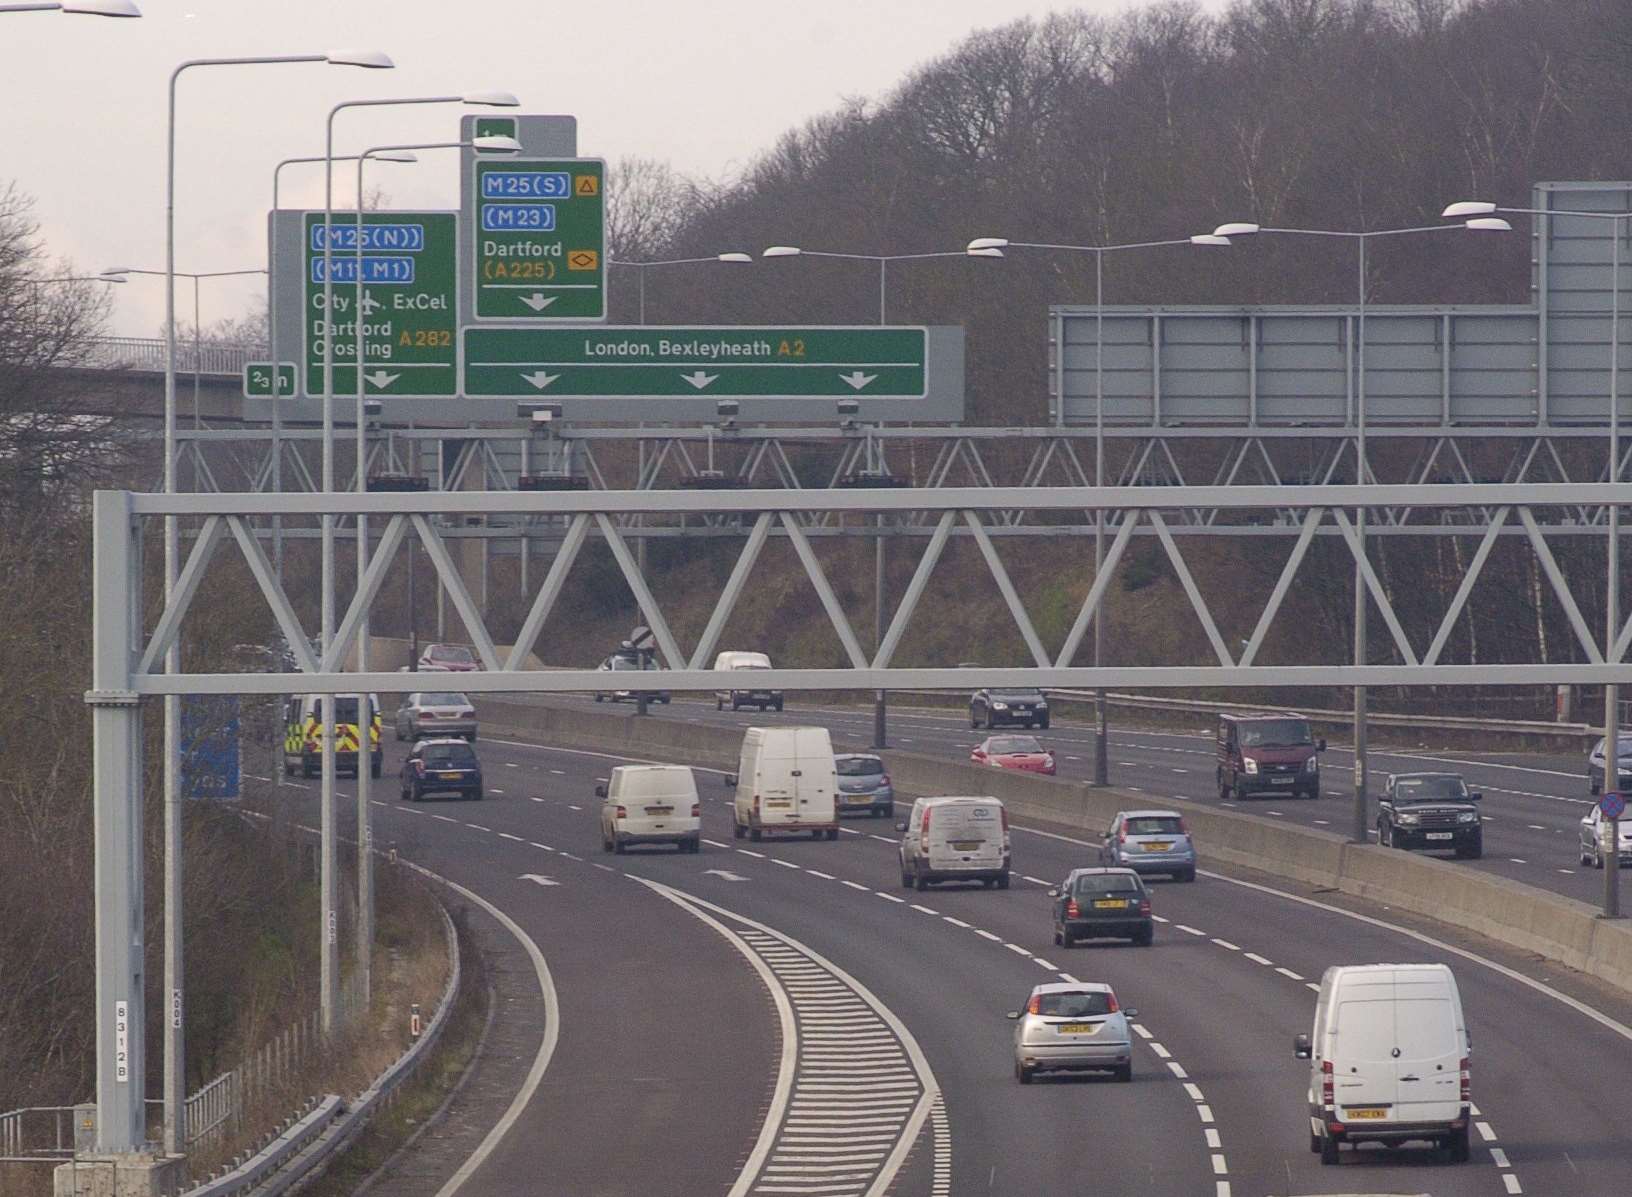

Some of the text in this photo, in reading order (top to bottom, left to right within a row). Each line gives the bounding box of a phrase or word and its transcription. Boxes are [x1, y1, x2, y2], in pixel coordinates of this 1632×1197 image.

[484, 241, 562, 257] Dartford
[393, 293, 447, 309] ExCel
[659, 340, 771, 359] Bexleyheath
